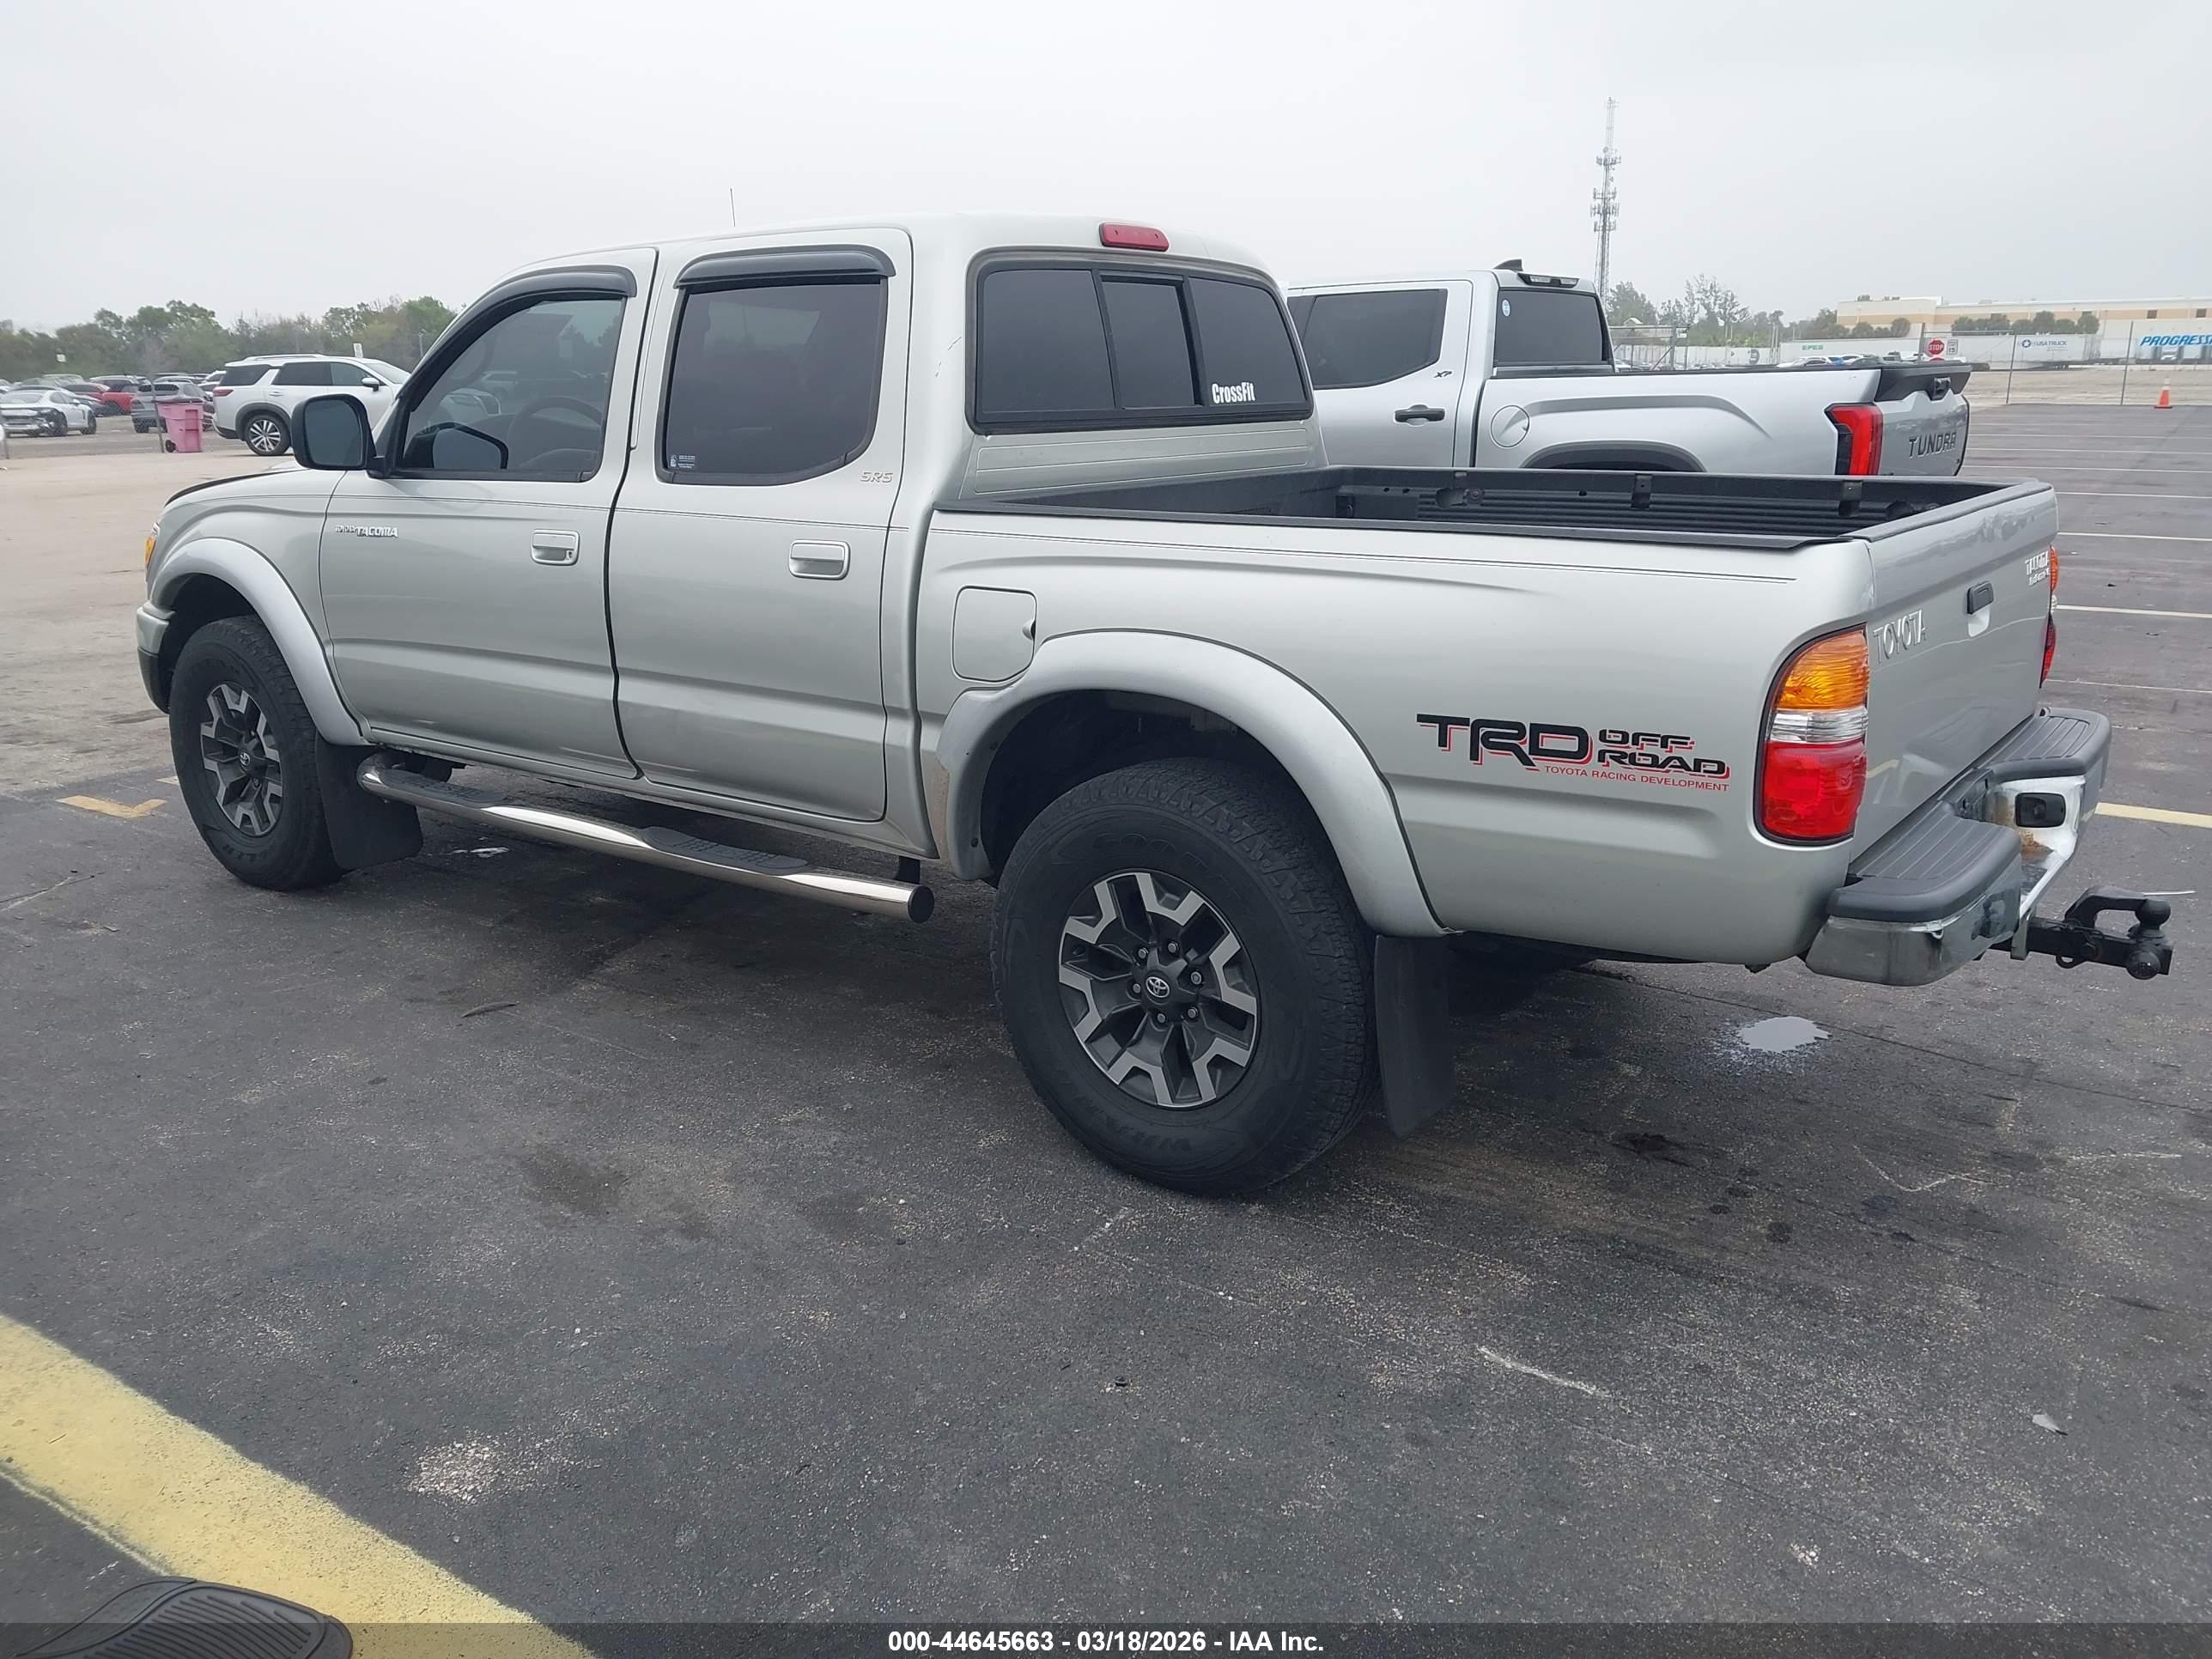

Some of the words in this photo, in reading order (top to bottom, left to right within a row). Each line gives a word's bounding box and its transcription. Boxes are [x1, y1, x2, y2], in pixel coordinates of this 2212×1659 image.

[1212, 381, 1255, 404] CrossFit
[1909, 432, 1957, 459] TUNDRA
[1873, 610, 1926, 664] TOYOTA
[1417, 713, 1594, 771] TRD
[1598, 728, 1695, 752] OFF
[1596, 748, 1731, 780] ROAD
[1545, 765, 1589, 778] TOYOTA
[1591, 770, 1637, 782] RACING
[1640, 775, 1730, 792] DEVELOPMENT
